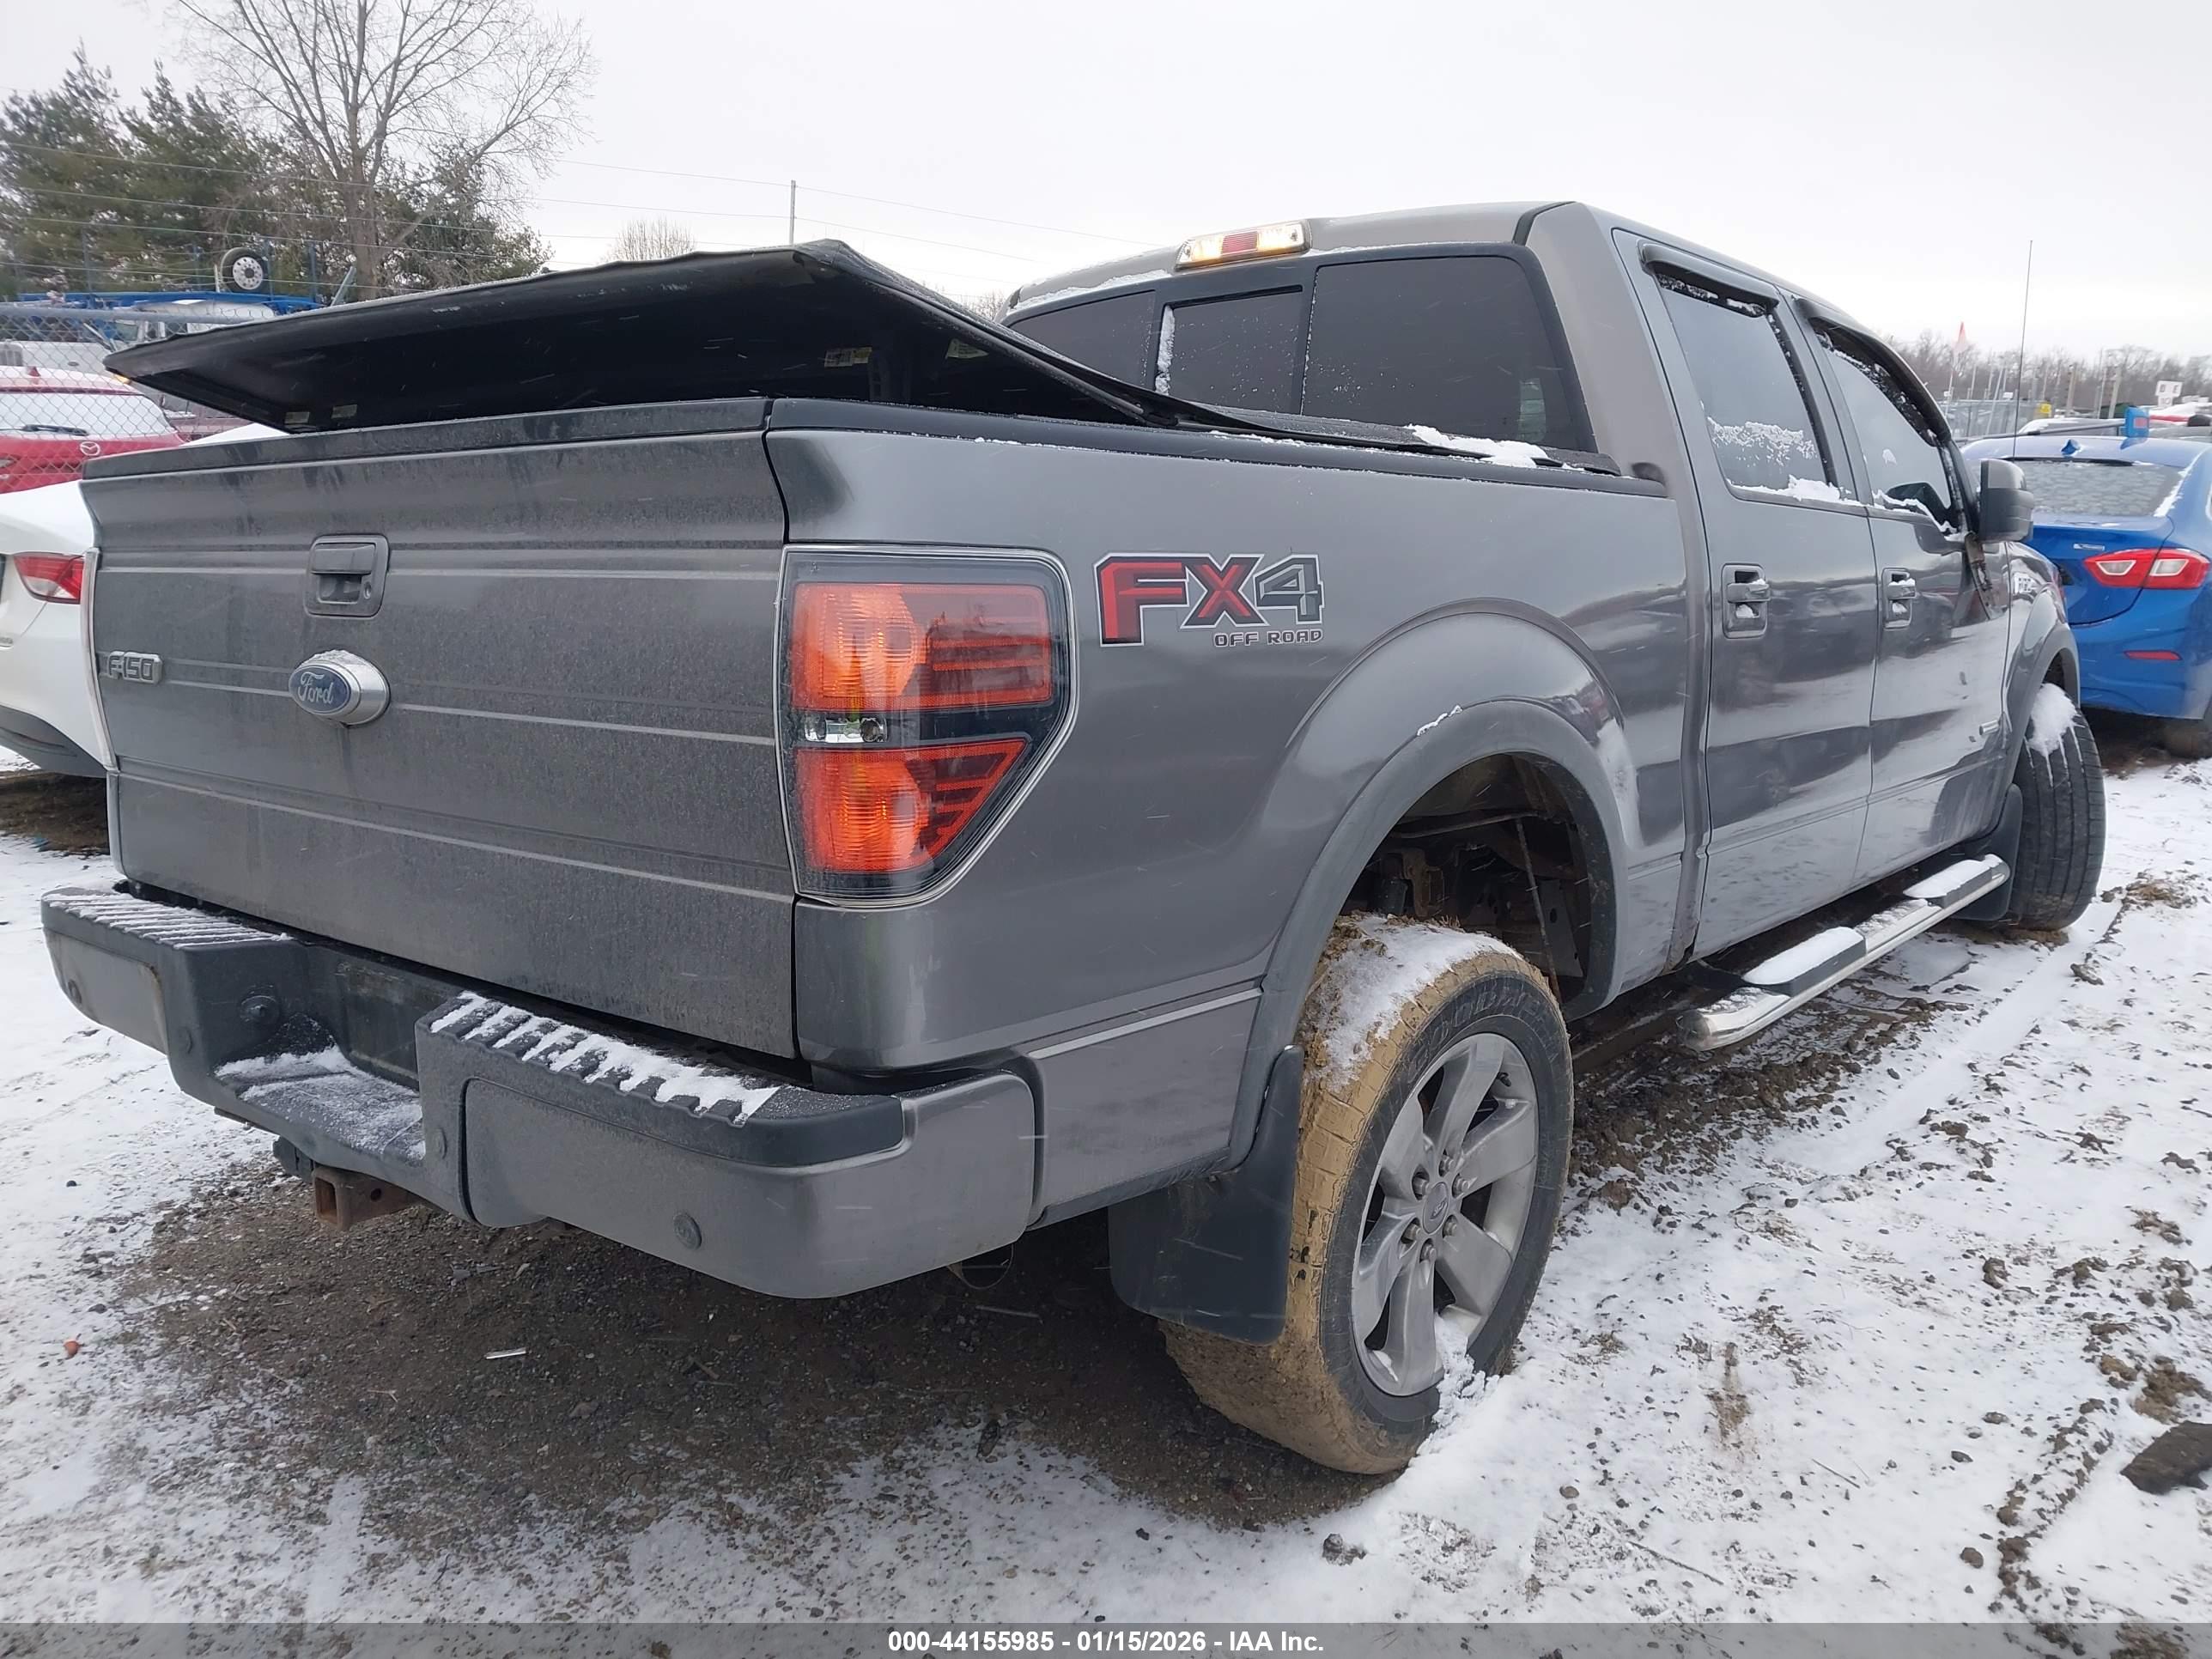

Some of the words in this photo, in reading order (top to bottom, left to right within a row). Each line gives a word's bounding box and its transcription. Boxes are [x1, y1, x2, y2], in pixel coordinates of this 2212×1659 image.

[1093, 552, 1324, 647] FX4
[1213, 632, 1259, 648] OFF
[1267, 629, 1324, 645] ROAD
[297, 671, 336, 705] Ford
